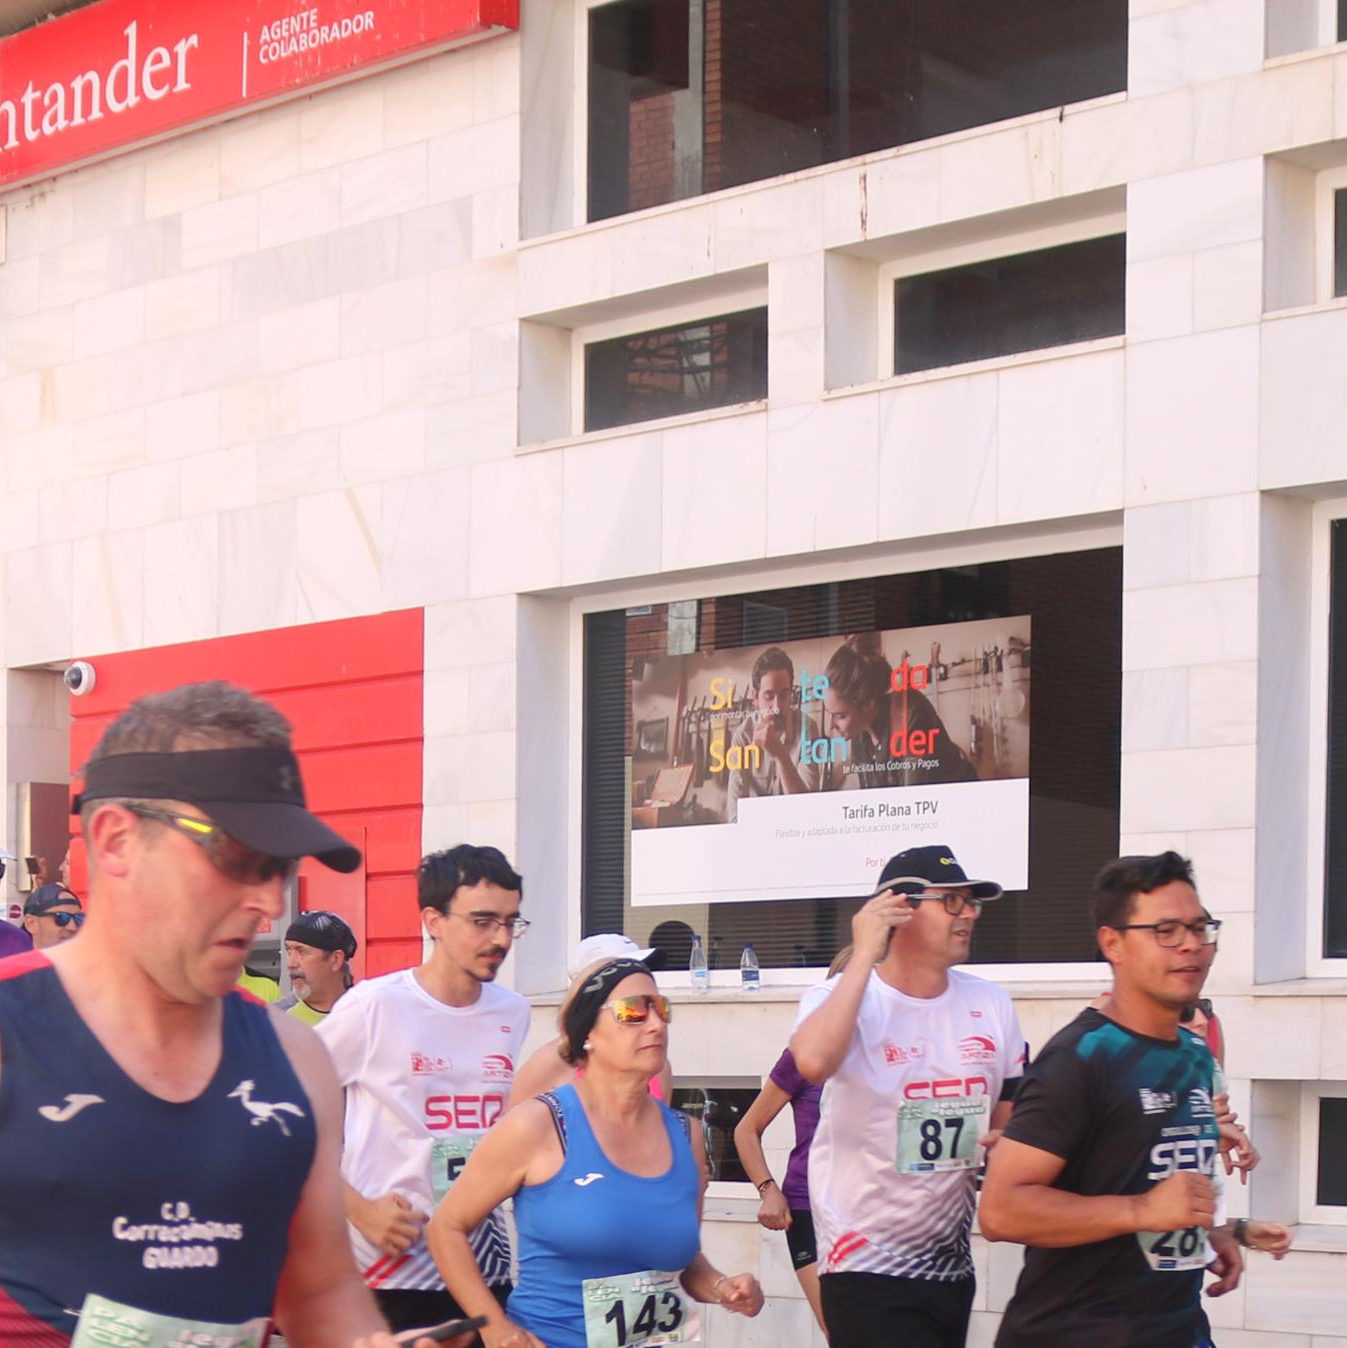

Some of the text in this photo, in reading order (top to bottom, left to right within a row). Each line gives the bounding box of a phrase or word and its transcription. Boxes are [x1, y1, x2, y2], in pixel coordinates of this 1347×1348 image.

[259, 8, 318, 45] AGENTE
[259, 10, 374, 64] COLABORADOR
[710, 658, 928, 711] Si te da
[709, 722, 940, 773] San tan der
[886, 760, 911, 771] Cobros
[917, 759, 939, 770] Pagos
[842, 800, 939, 820] Tarifa Plana TPV
[865, 857, 879, 868] Por
[920, 1117, 964, 1161] 87
[143, 1246, 219, 1269] GUARDO
[605, 1291, 683, 1347] 143
